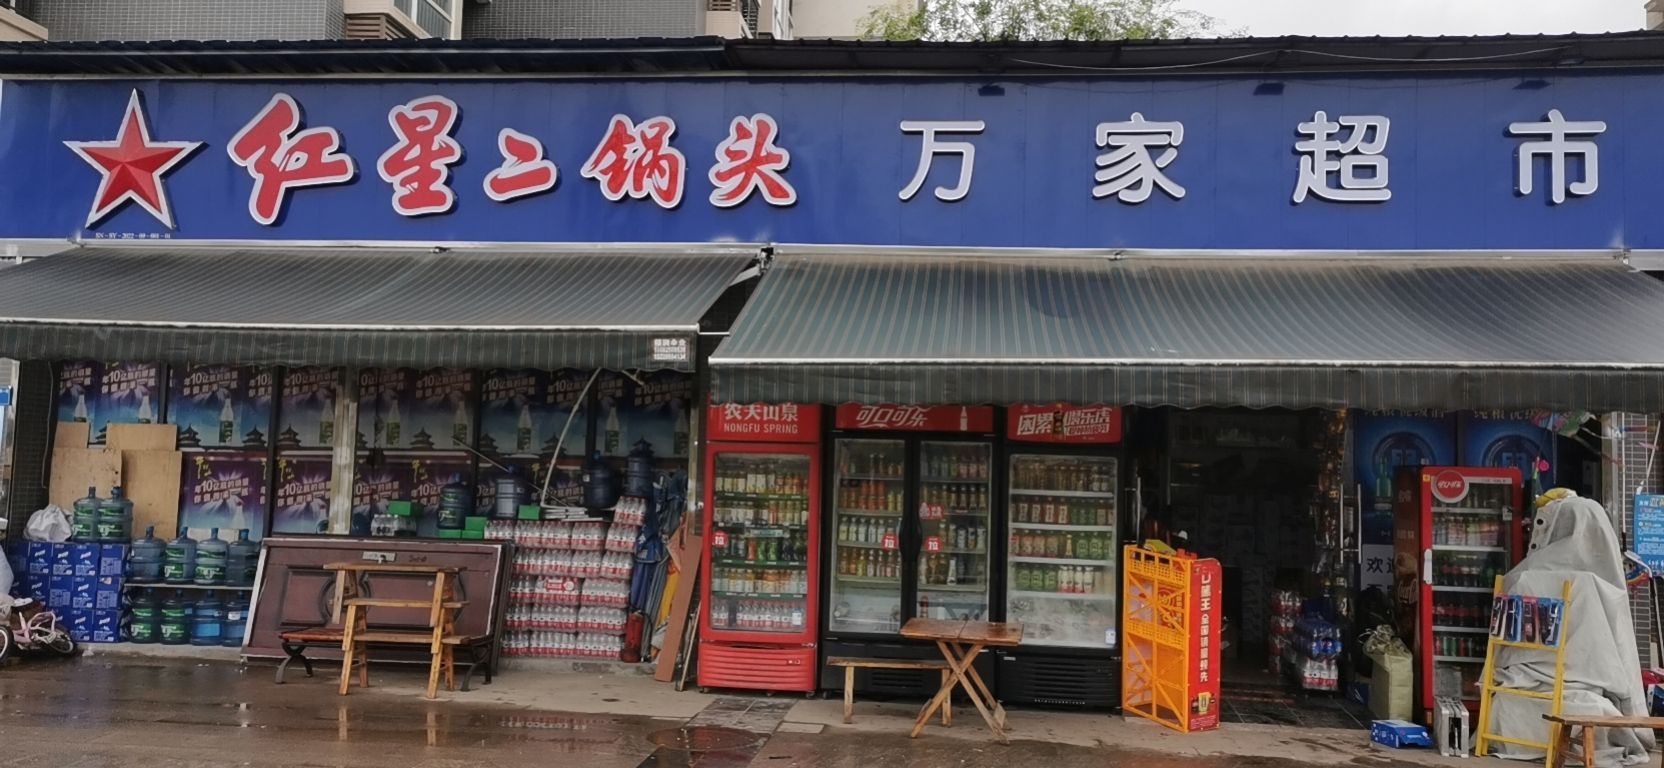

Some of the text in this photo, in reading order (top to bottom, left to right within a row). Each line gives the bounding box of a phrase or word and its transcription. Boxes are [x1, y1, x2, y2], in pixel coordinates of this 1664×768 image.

[227, 92, 797, 225] 红星二锅头
[898, 109, 1607, 204] 万家超市
[724, 403, 799, 421] 农夫山泉
[724, 423, 798, 434] NONGFU SPRING
